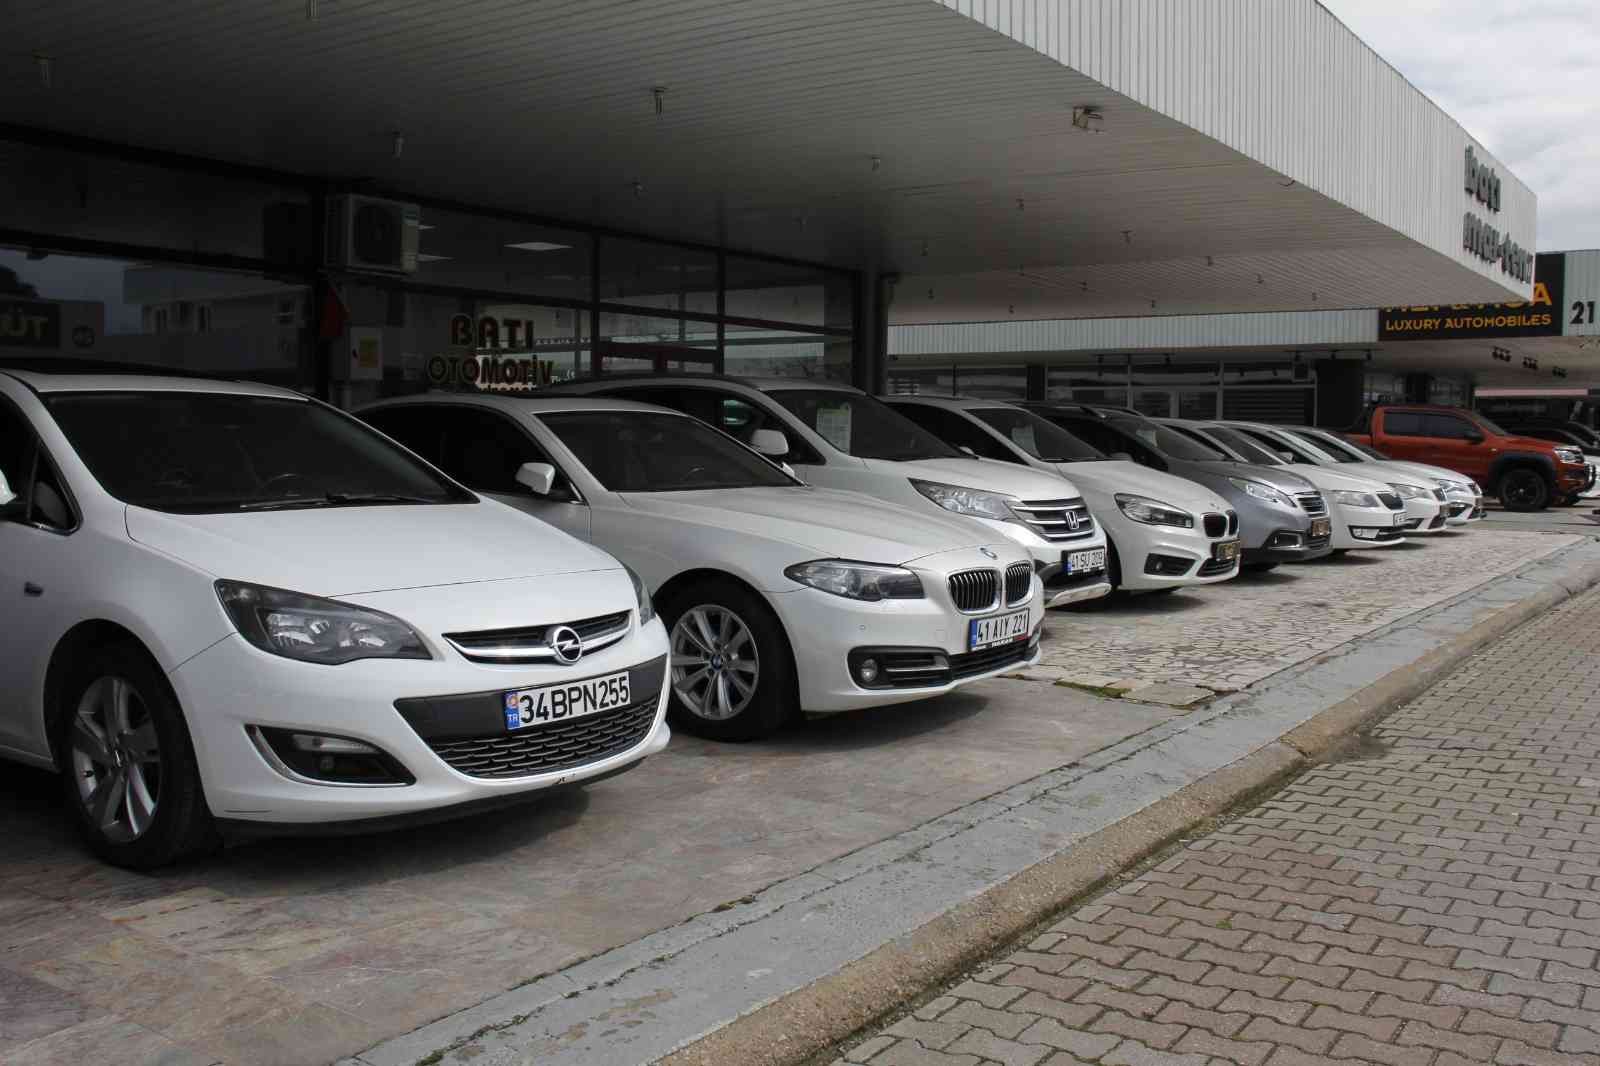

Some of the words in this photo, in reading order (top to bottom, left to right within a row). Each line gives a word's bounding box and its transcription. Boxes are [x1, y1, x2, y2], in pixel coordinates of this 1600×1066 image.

[1385, 317, 1441, 331] LUXURY
[1444, 313, 1552, 329] AUTOMOBILES
[1570, 301, 1595, 324] 21
[452, 314, 534, 349] BATI
[978, 621, 990, 642] 41
